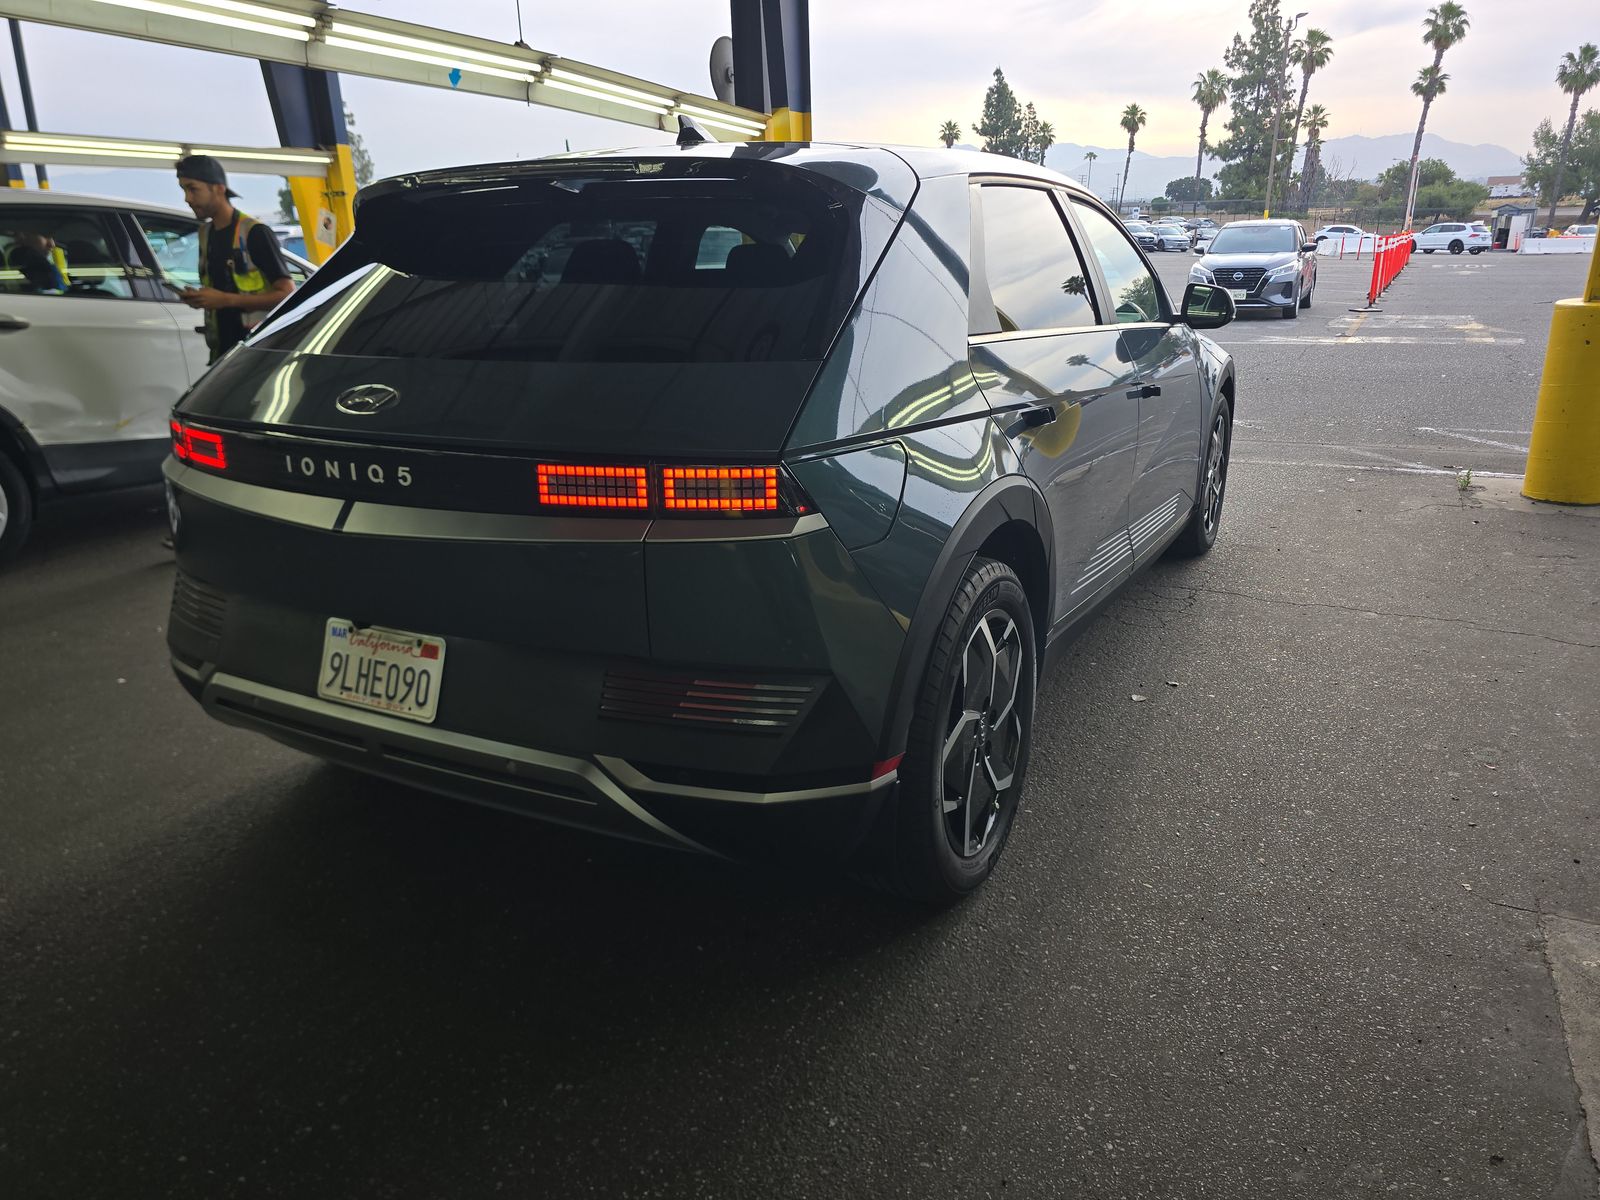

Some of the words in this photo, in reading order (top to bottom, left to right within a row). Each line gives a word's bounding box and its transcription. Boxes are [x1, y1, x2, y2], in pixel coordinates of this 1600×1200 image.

[286, 455, 384, 484] IONIQ
[397, 466, 413, 487] 5
[349, 631, 413, 655] California
[325, 652, 431, 707] 9LHE090
